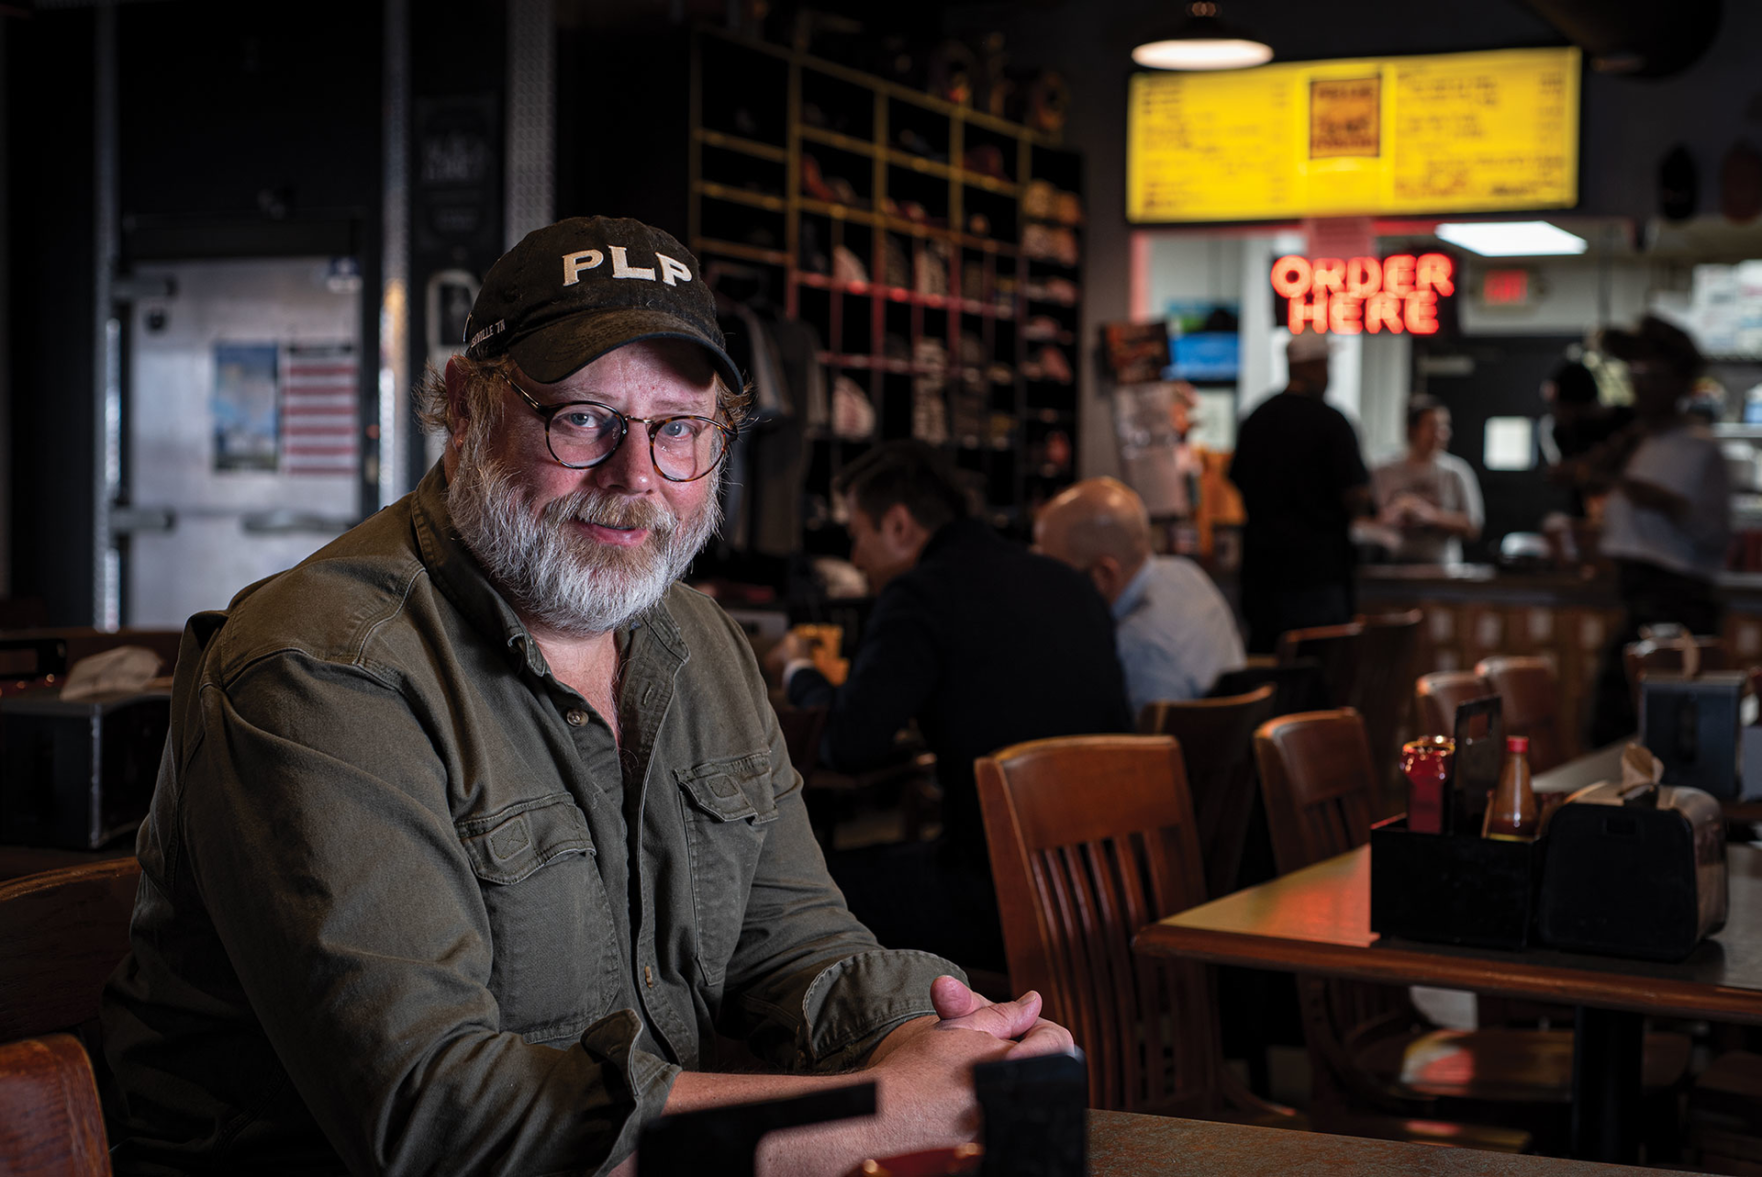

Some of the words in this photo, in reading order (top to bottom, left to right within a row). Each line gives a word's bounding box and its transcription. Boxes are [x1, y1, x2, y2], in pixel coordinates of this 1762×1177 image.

[561, 244, 693, 287] PLP
[1271, 253, 1455, 299] ORDER
[1287, 291, 1440, 335] HERE
